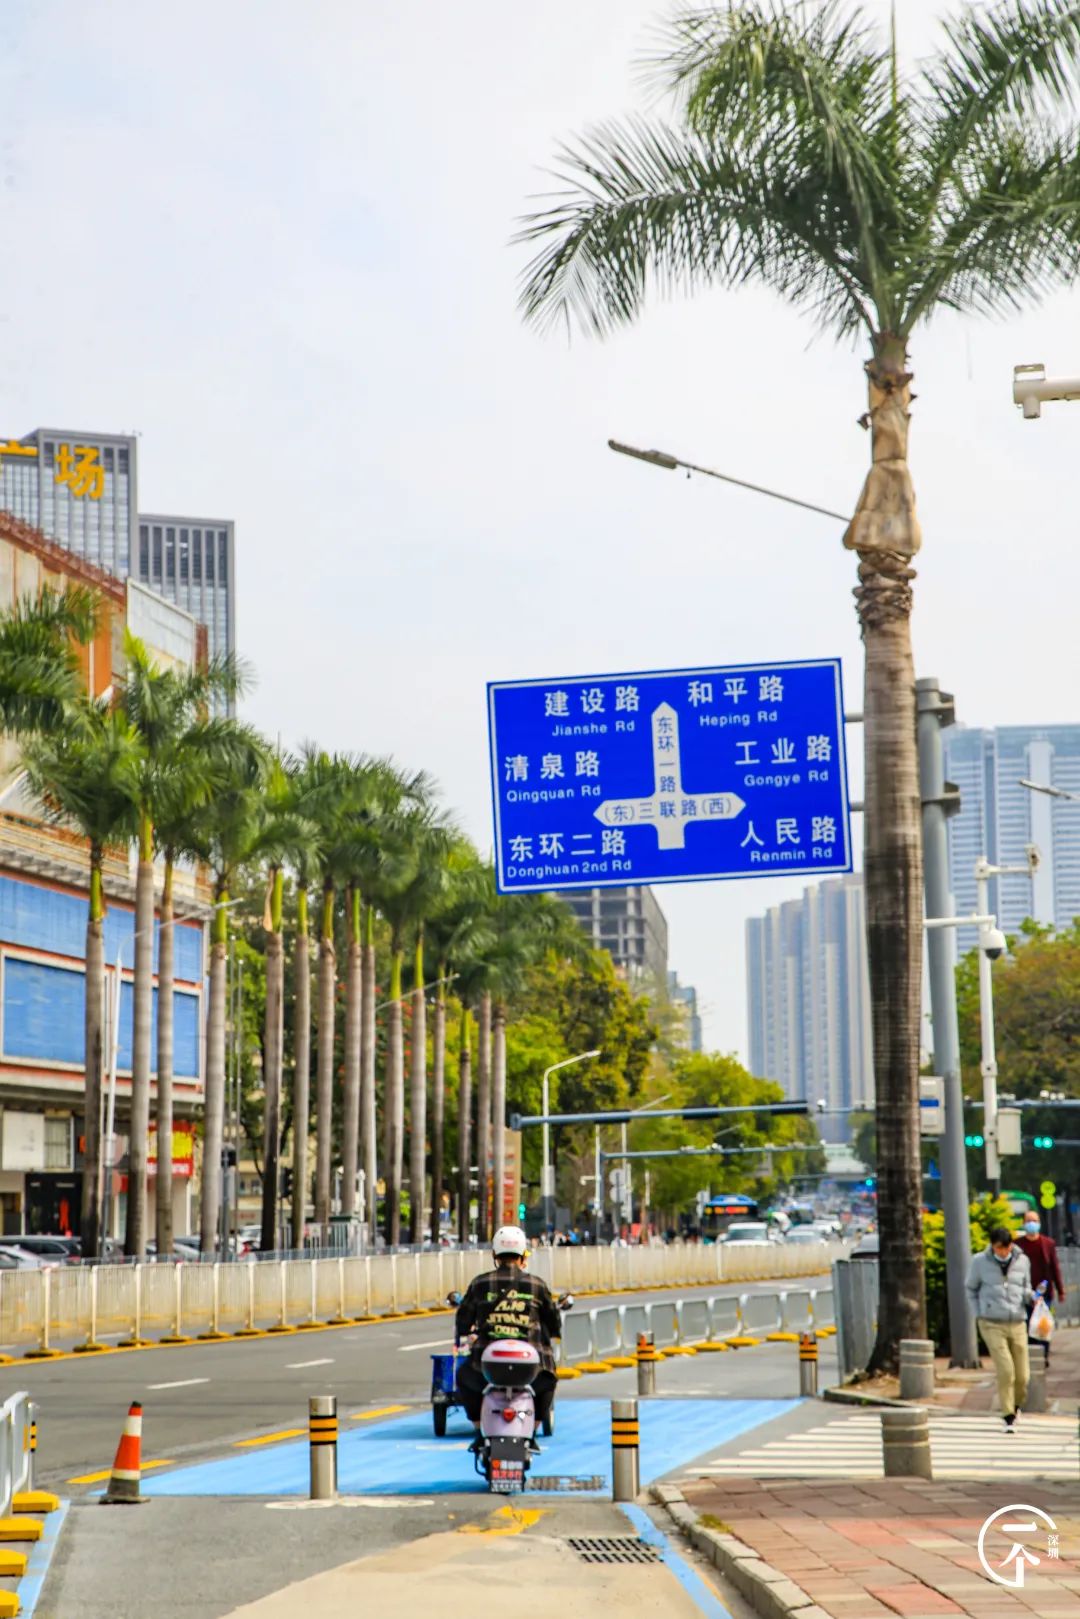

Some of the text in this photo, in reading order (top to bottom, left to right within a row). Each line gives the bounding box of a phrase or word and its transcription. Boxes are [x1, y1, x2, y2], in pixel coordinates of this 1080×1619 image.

[544, 684, 641, 717] 建设路
[687, 674, 785, 708] 和平路
[551, 720, 635, 737] Jianshe Rd
[699, 710, 778, 728] Heping Rd
[657, 716, 676, 793] 东环一路
[735, 734, 833, 766] 工业路
[504, 750, 601, 783] 清泉路
[743, 770, 829, 788] Gongye Rd
[506, 784, 601, 803] Qingquan Rd
[509, 829, 627, 863] 东环二路
[740, 816, 837, 848] 人民路
[507, 858, 632, 879] Donghuan 2nd Rd
[750, 846, 832, 863] Renmin Rd
